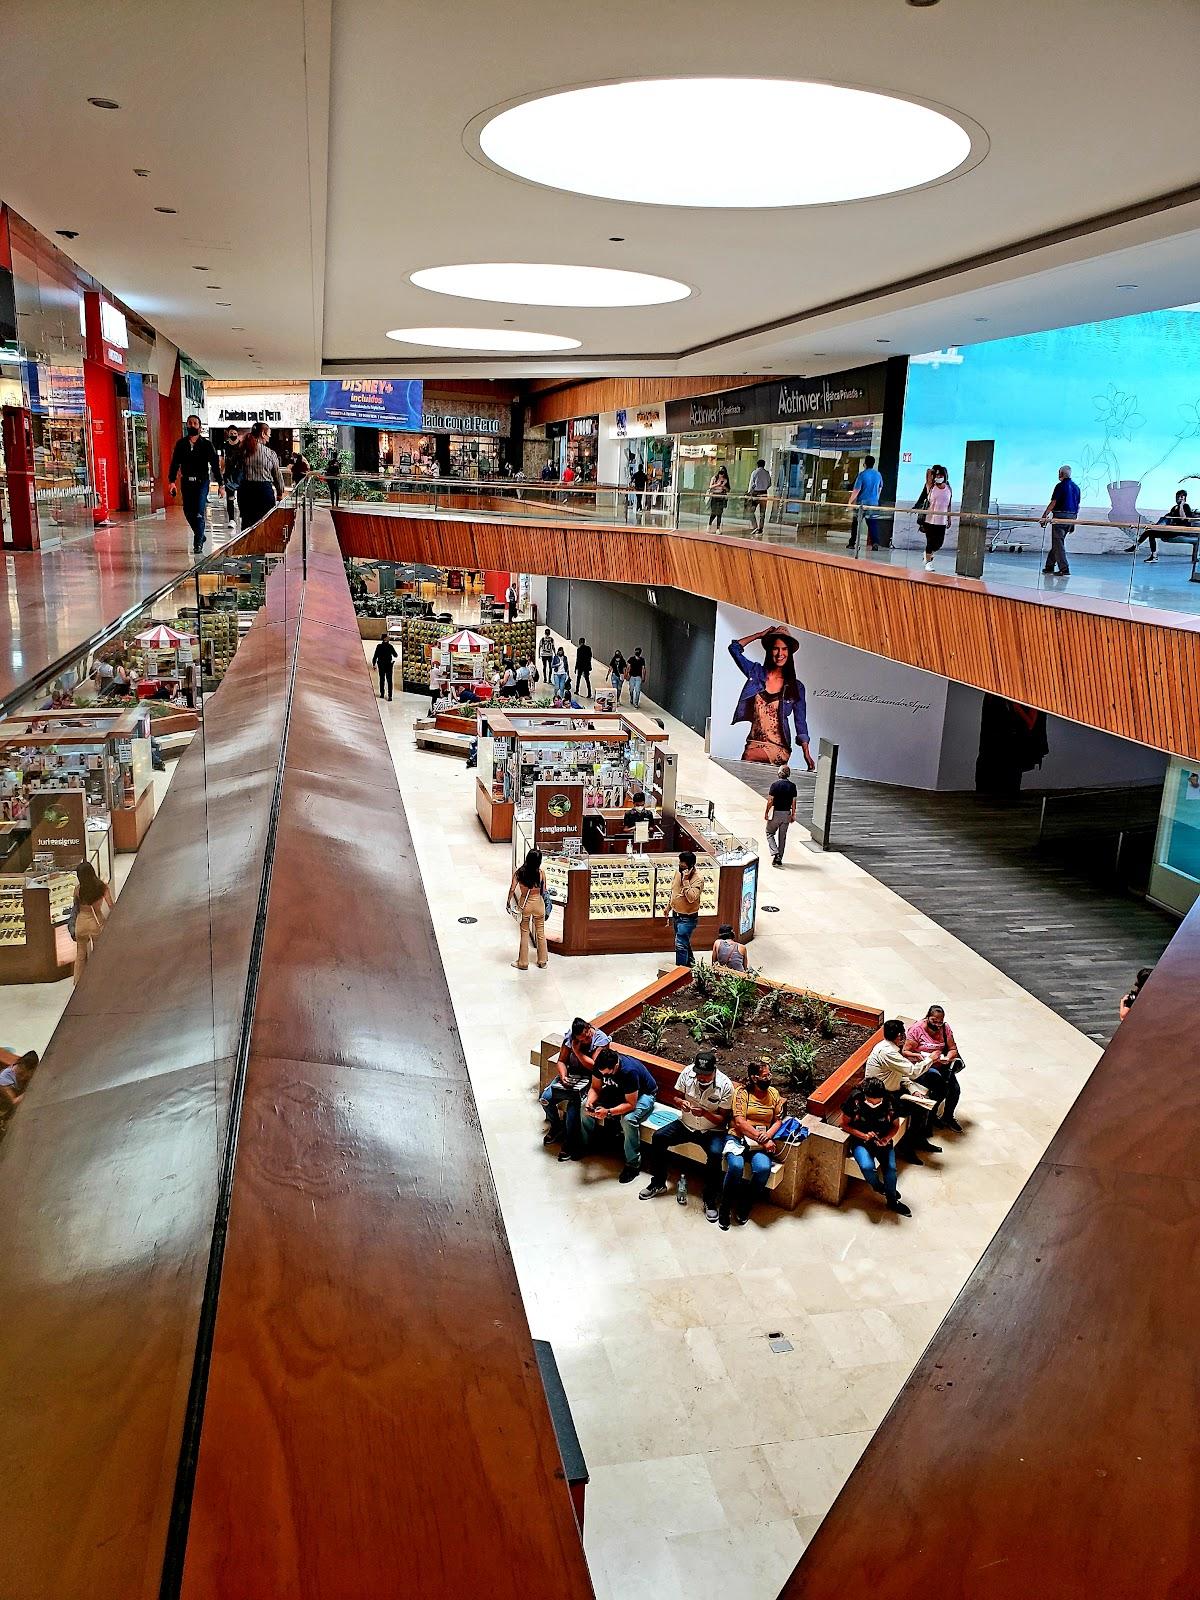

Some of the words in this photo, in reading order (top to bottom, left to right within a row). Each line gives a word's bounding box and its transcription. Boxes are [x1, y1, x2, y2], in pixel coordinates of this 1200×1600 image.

[341, 380, 394, 394] DISNEY+
[350, 393, 383, 404] incluidos
[444, 415, 462, 432] con
[463, 416, 473, 431] el
[473, 416, 500, 433] Perro
[540, 825, 566, 834] sunglass
